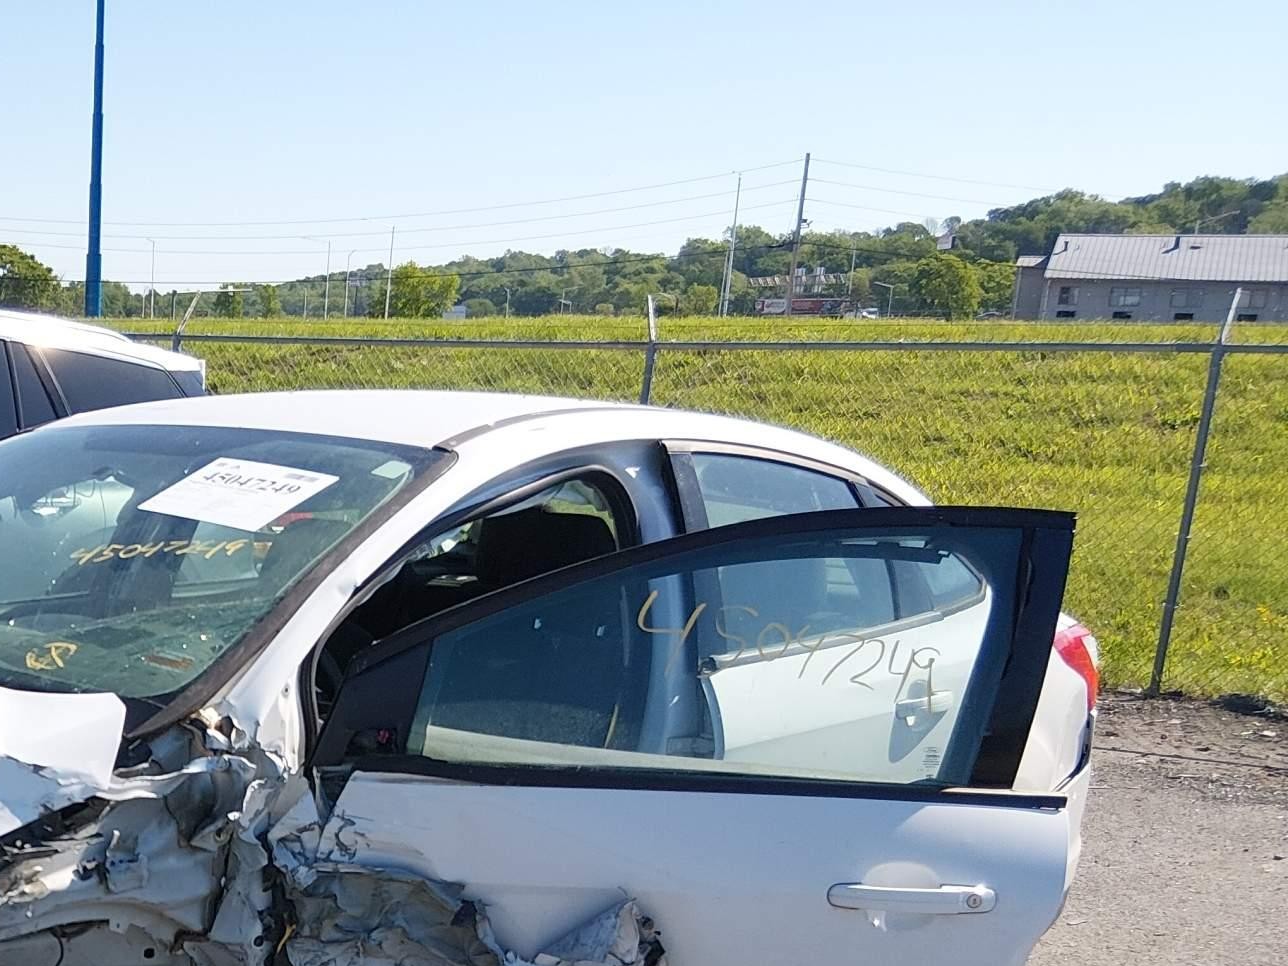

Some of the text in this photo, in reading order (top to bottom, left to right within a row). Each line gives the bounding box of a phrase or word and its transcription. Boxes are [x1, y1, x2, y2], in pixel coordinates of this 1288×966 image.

[203, 471, 302, 496] 45047249
[70, 539, 248, 566] 45047249
[637, 589, 941, 713] 45047249
